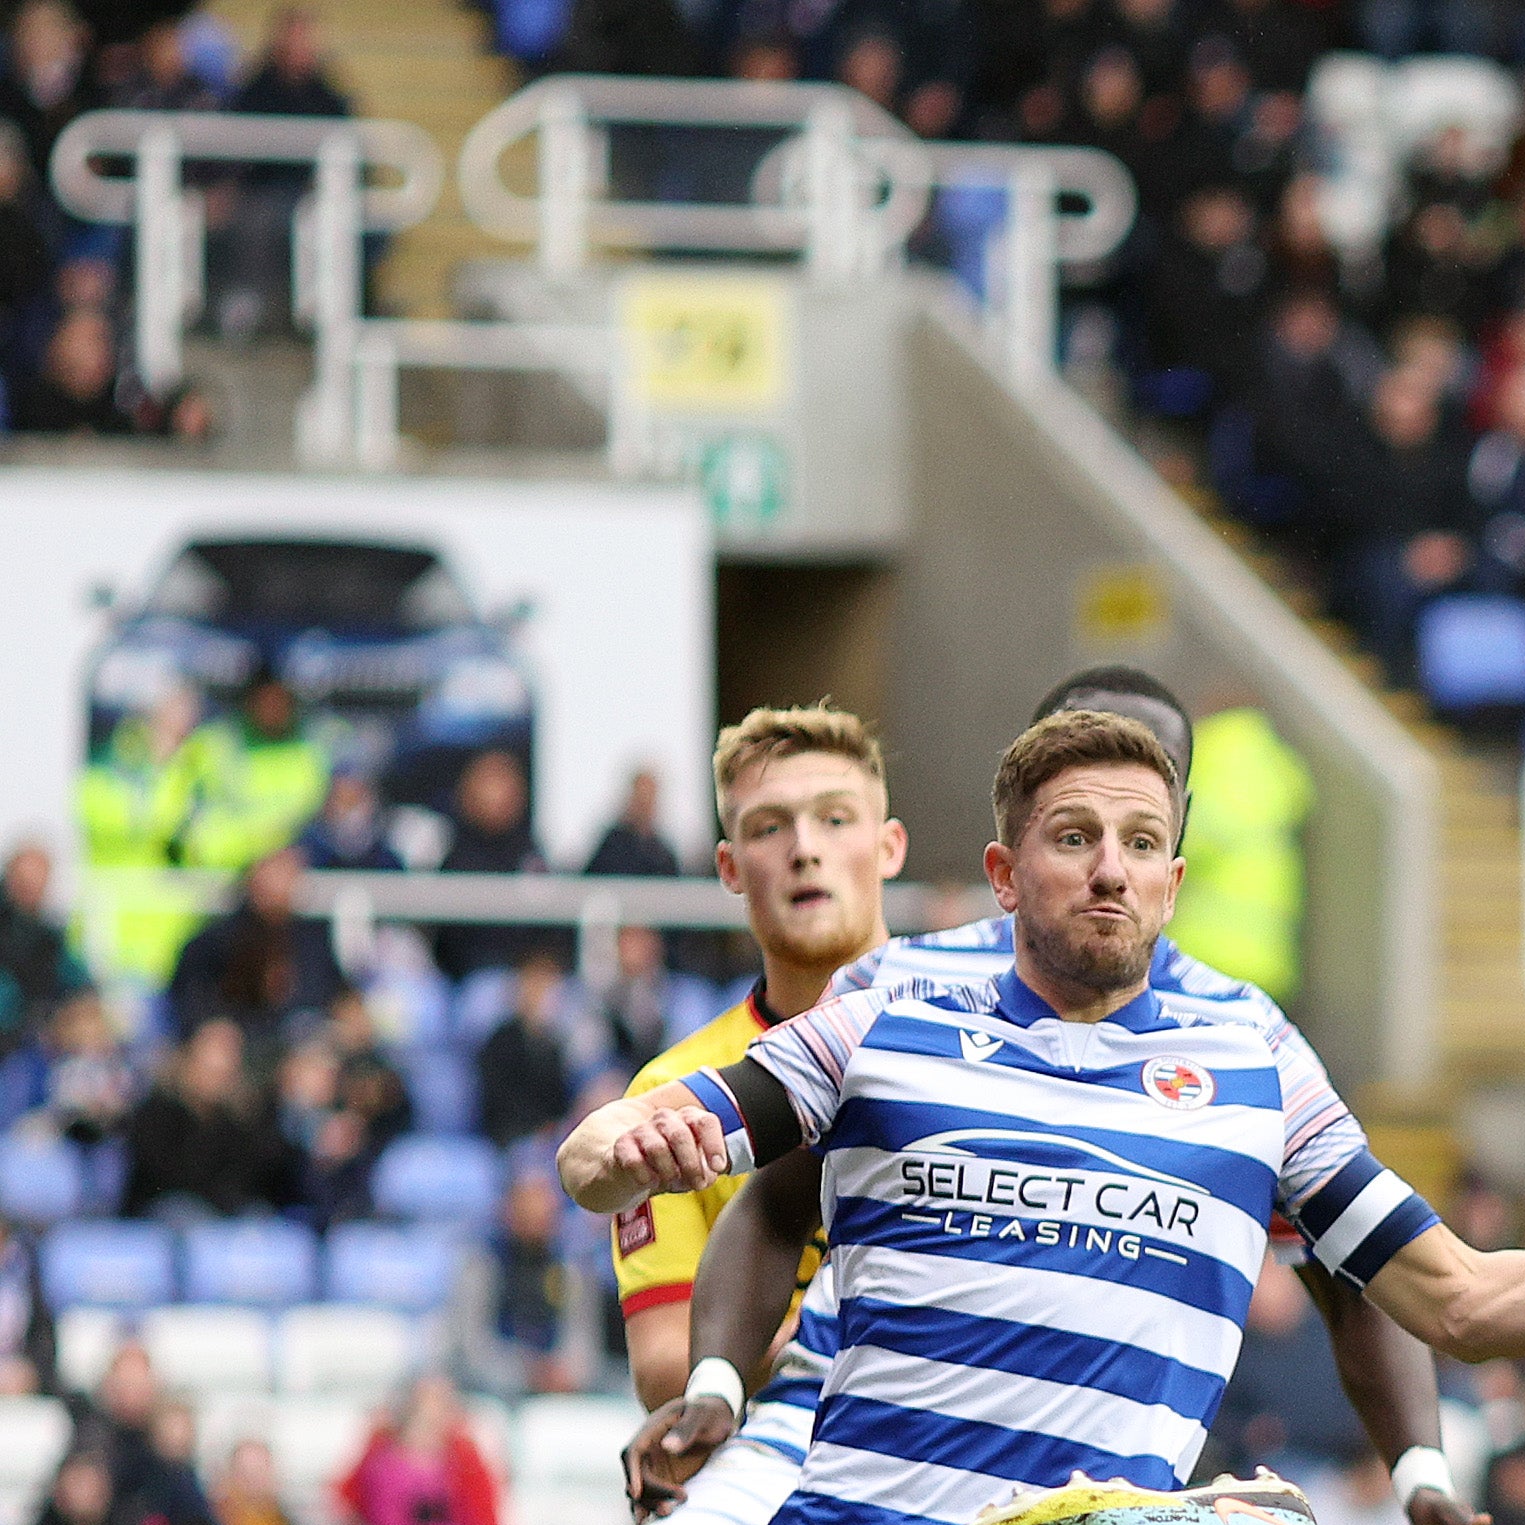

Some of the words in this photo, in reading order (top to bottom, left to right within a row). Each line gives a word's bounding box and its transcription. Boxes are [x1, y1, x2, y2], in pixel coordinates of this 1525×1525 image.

[902, 1160, 1086, 1213] SELECT
[1094, 1182, 1200, 1238] CAR
[943, 1210, 1142, 1261] LEASING
